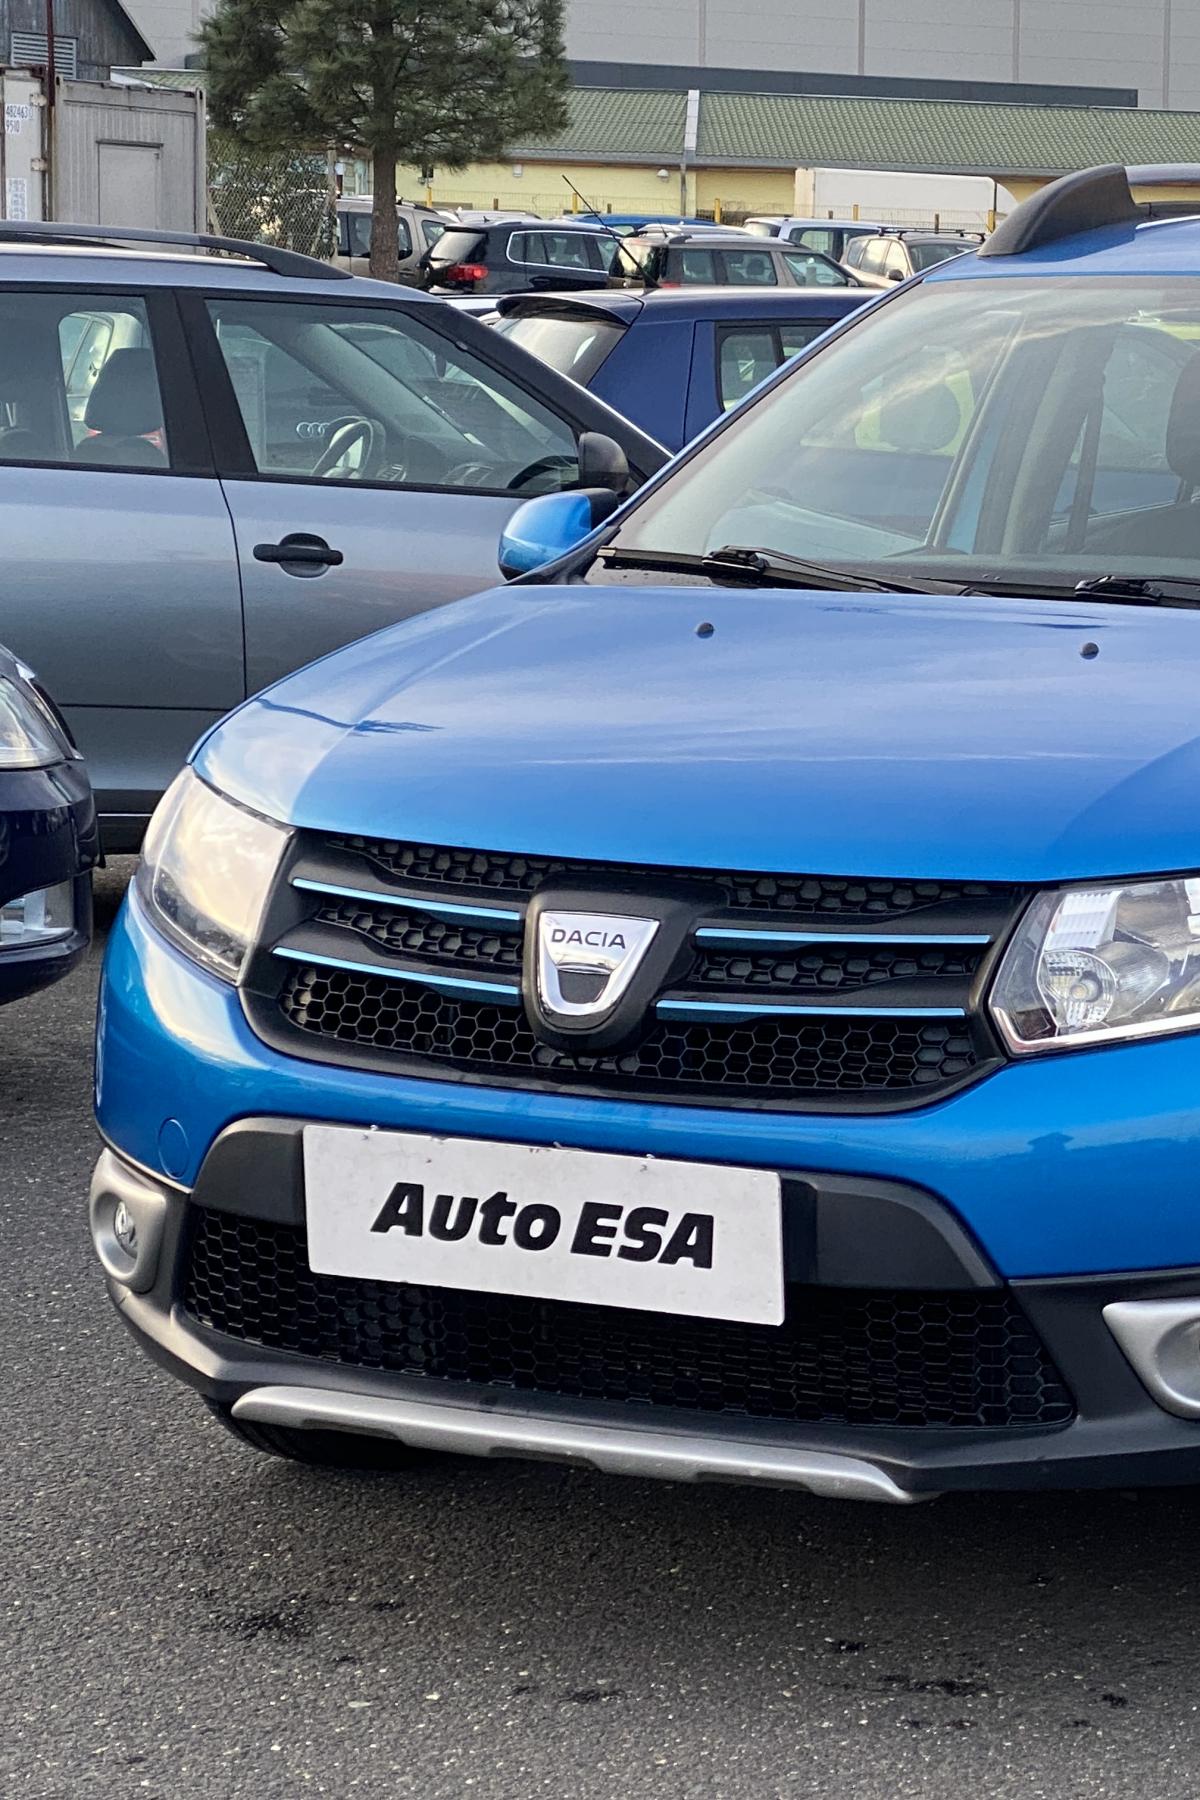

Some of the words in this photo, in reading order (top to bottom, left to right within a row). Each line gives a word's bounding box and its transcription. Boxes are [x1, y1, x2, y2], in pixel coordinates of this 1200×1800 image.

[551, 929, 626, 949] DACIA
[370, 1182, 561, 1251] Auto
[570, 1202, 714, 1269] ESA
